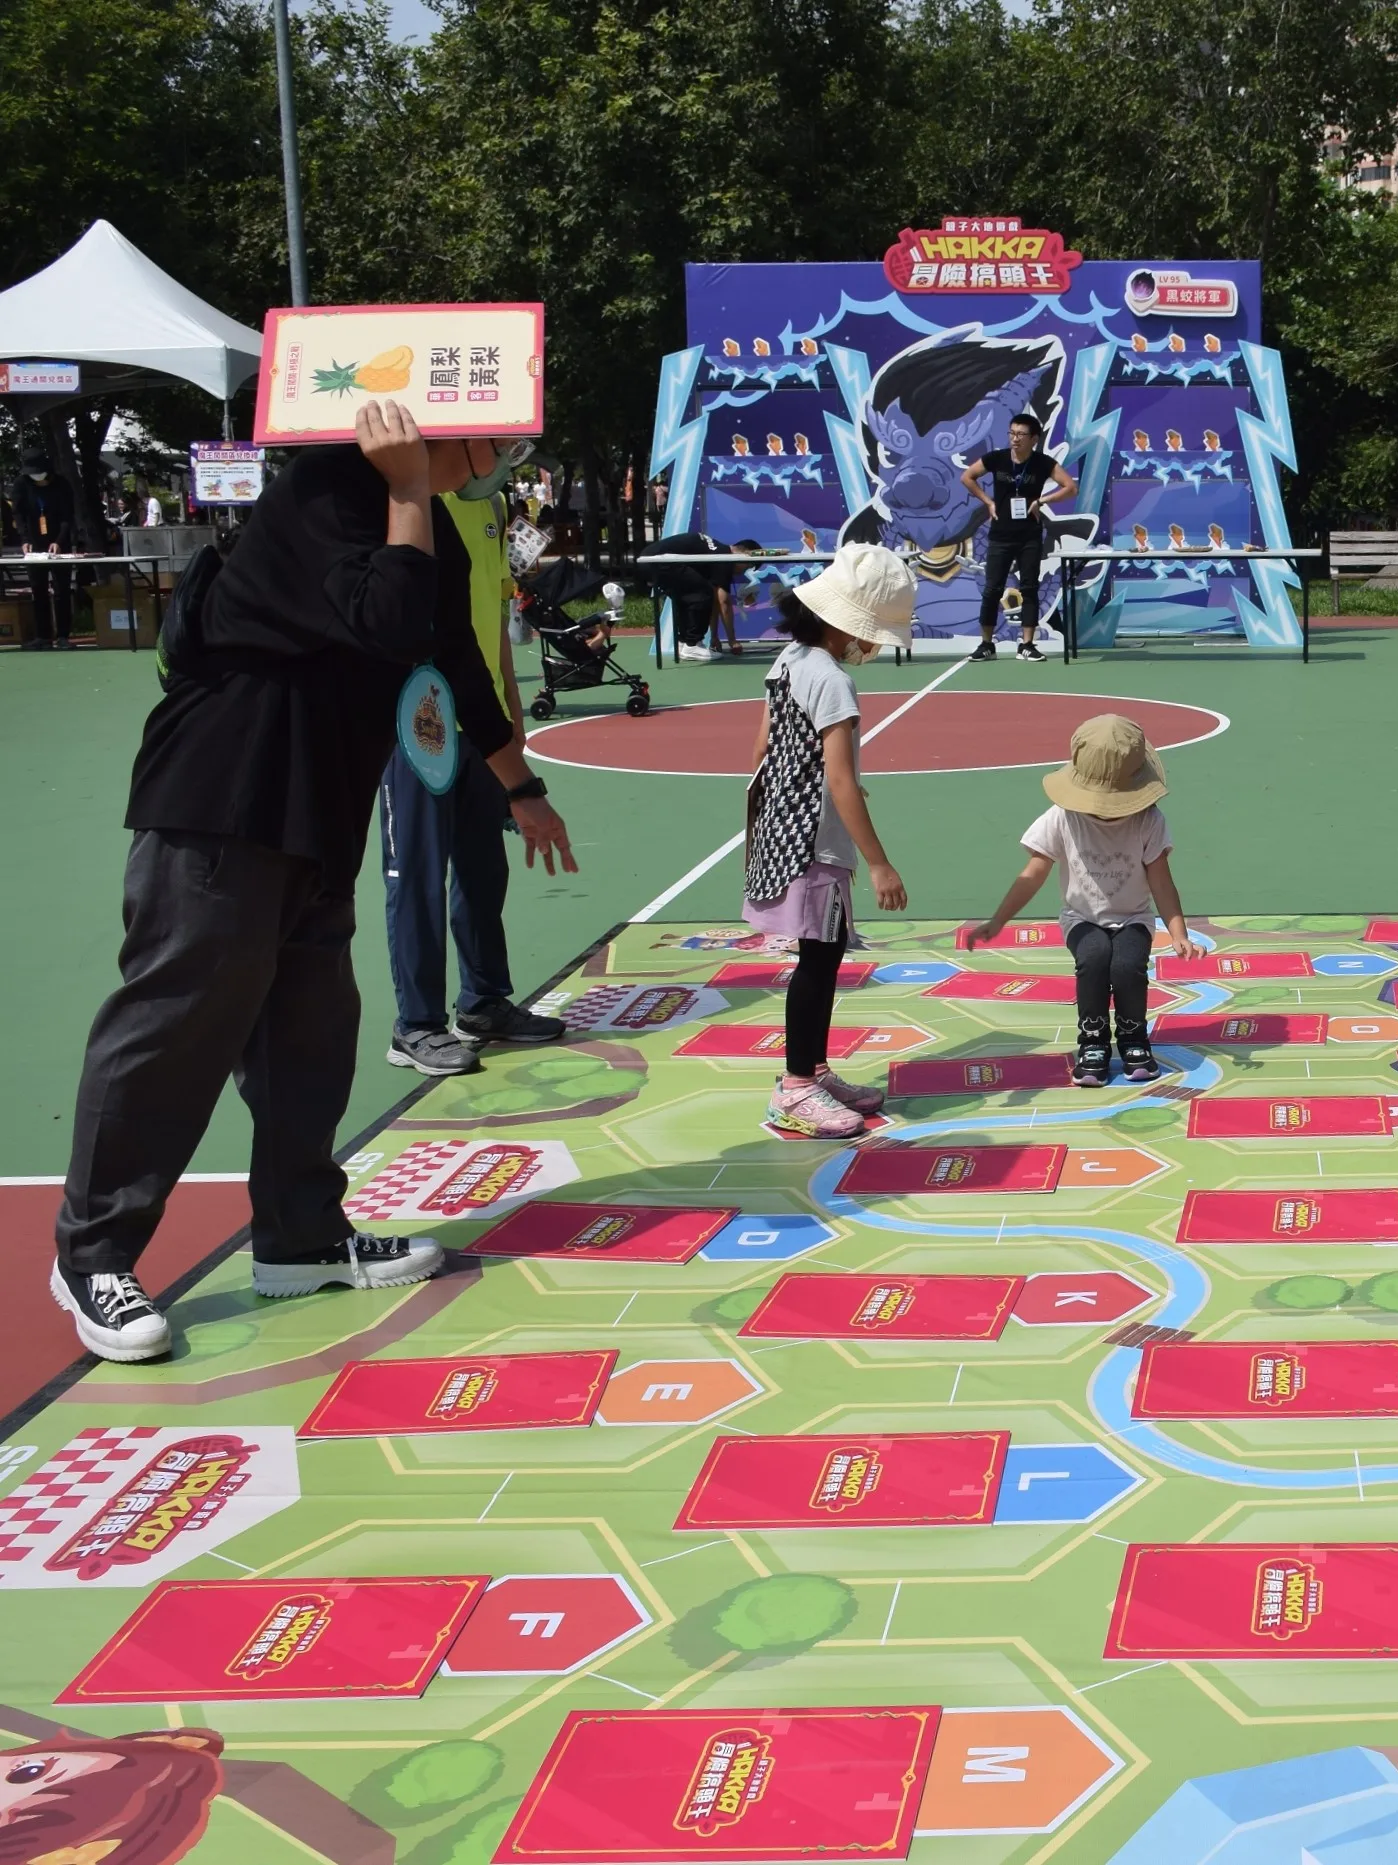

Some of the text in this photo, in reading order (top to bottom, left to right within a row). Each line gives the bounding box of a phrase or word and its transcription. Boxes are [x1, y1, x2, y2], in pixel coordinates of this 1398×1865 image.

[945, 221, 1019, 232] 親子大地遊戲
[919, 236, 1046, 259] HAKKA
[907, 262, 1060, 288] 冒險搞頭王
[1159, 275, 1181, 284] LV 95
[1166, 289, 1221, 303] 黑蛟將軍
[430, 346, 461, 387] 鳳梨
[468, 346, 500, 387] 黃梨
[466, 1155, 530, 1202] HAKKA
[1080, 1156, 1117, 1172] J
[737, 1231, 780, 1245] D
[1054, 1291, 1098, 1307] K
[457, 1376, 487, 1408] HAKKA
[638, 1383, 693, 1401] E
[1275, 1361, 1290, 1395] HAKKA
[841, 1458, 869, 1499] HAKKA
[1015, 1471, 1069, 1491] L
[57, 1449, 201, 1563] 冒險搞頭王
[125, 1455, 241, 1552] HAKKA
[1284, 1572, 1305, 1624] HAKKA
[268, 1609, 320, 1662] HAKKA
[508, 1612, 566, 1638] F
[716, 1746, 759, 1814] HAKKA
[961, 1744, 1026, 1784] M
